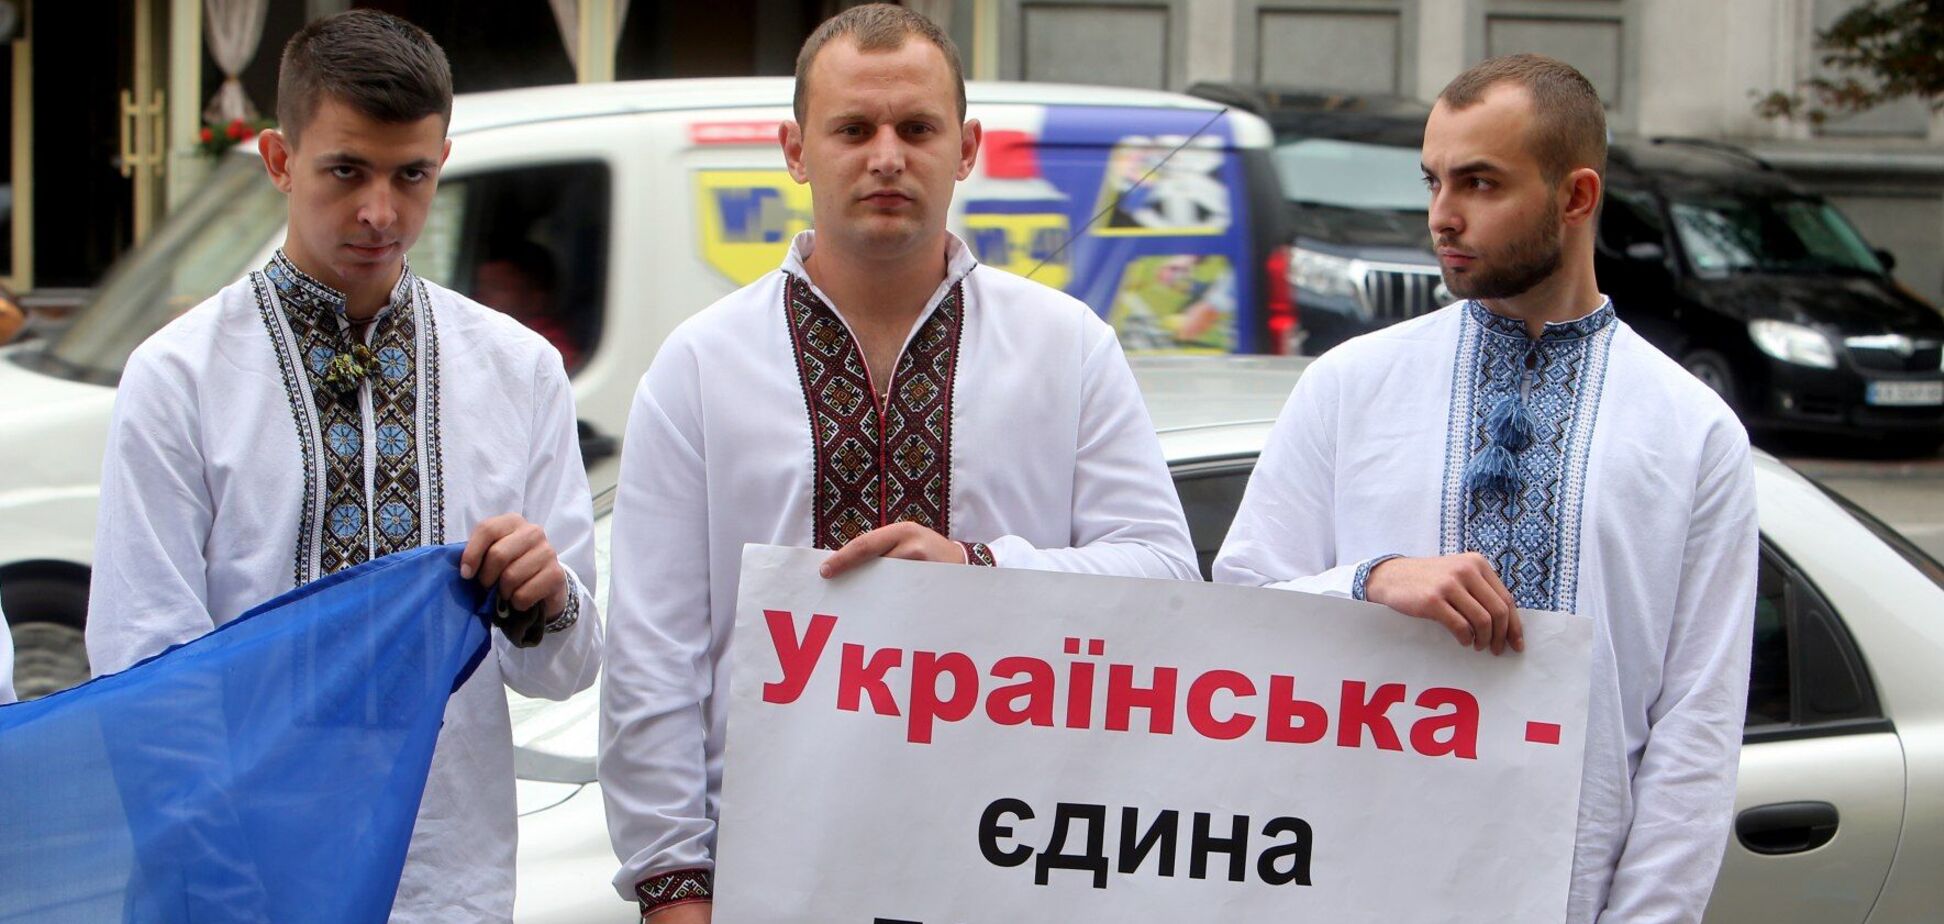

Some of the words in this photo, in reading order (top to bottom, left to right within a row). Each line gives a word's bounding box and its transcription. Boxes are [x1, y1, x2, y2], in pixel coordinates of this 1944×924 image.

[763, 609, 1480, 760] Українська
[1525, 721, 1561, 745] -
[978, 798, 1313, 889] єдина
